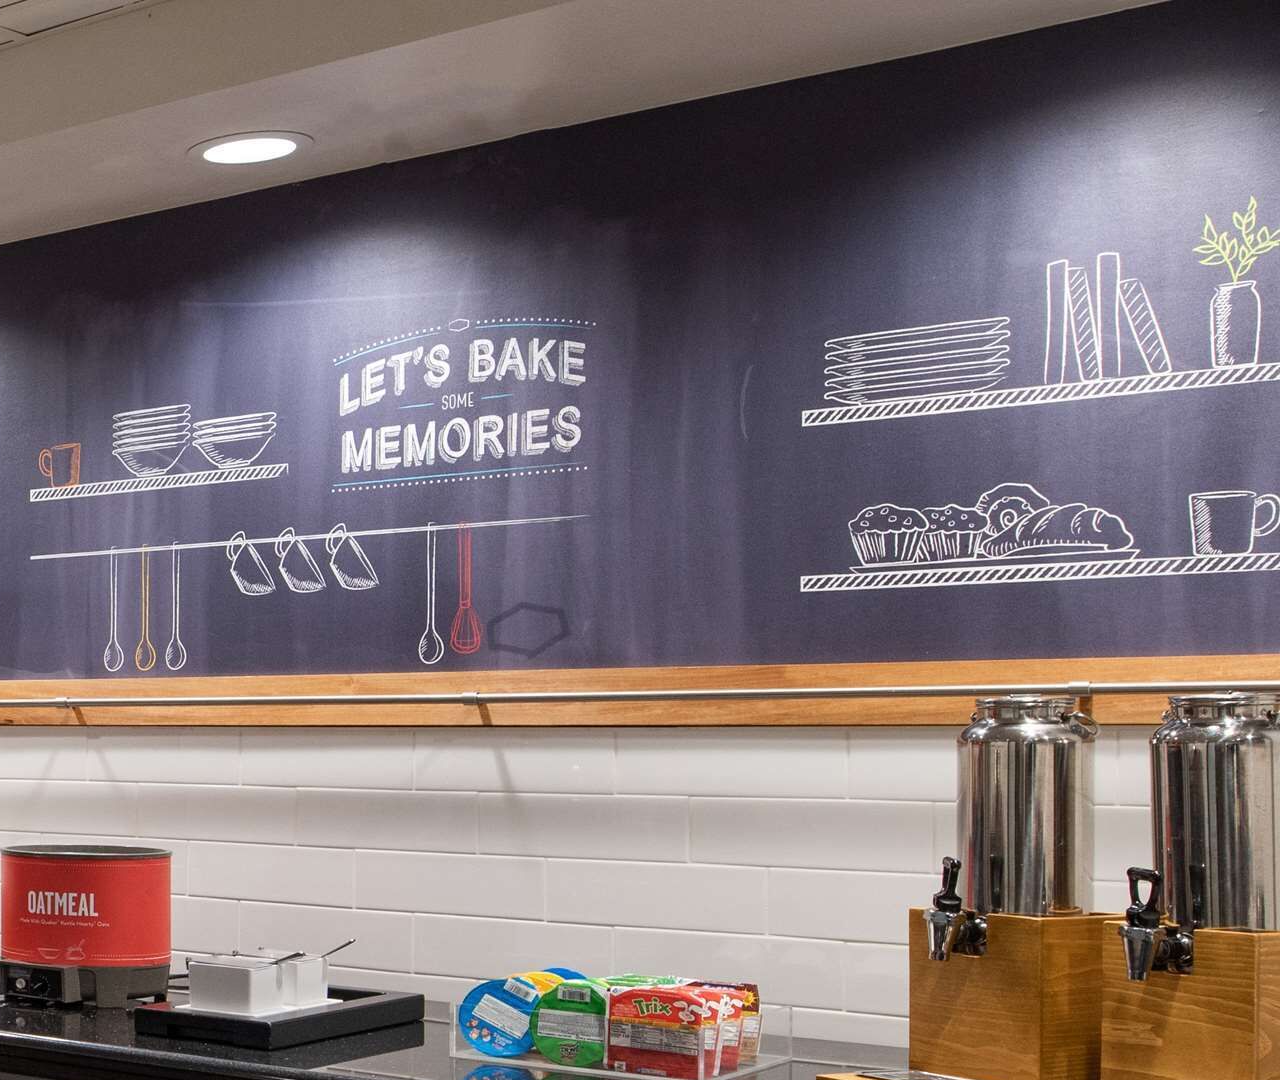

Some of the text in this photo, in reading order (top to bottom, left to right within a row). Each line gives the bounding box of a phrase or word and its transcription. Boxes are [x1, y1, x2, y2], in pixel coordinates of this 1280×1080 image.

[339, 337, 586, 417] LET'S BAKE
[440, 391, 475, 411] SOME
[340, 405, 583, 474] MEMORIES
[27, 890, 99, 917] OATMEAL
[632, 996, 673, 1017] Trix
